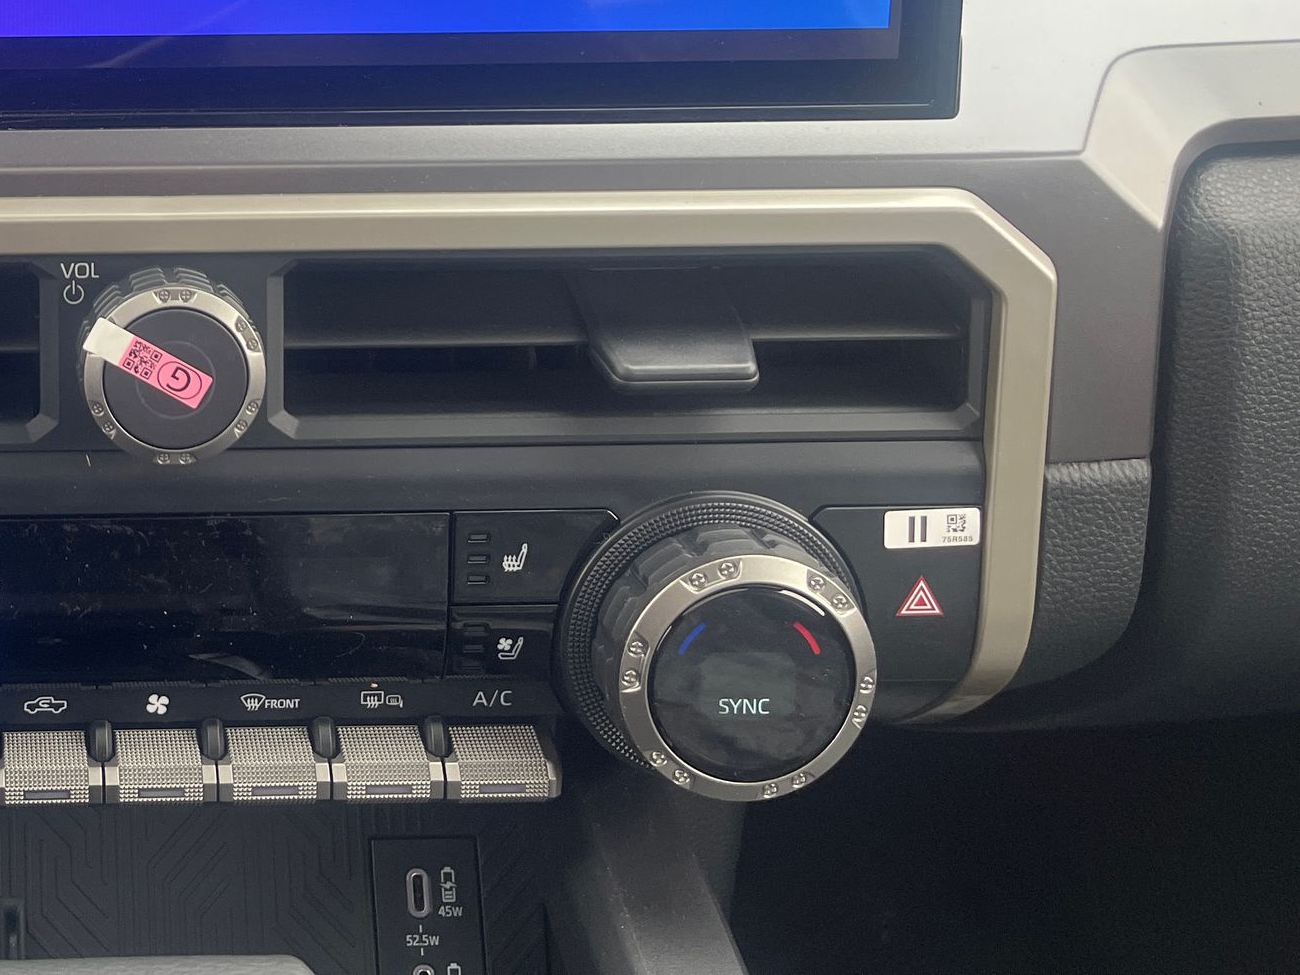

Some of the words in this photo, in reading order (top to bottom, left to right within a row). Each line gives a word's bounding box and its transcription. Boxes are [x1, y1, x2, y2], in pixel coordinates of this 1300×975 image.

[60, 262, 100, 279] VOL
[166, 366, 191, 392] G
[264, 698, 301, 709] FRONT
[472, 689, 513, 708] A/C
[718, 697, 770, 716] SYNC
[437, 905, 463, 917] 45W
[406, 934, 440, 947] 52.5W
